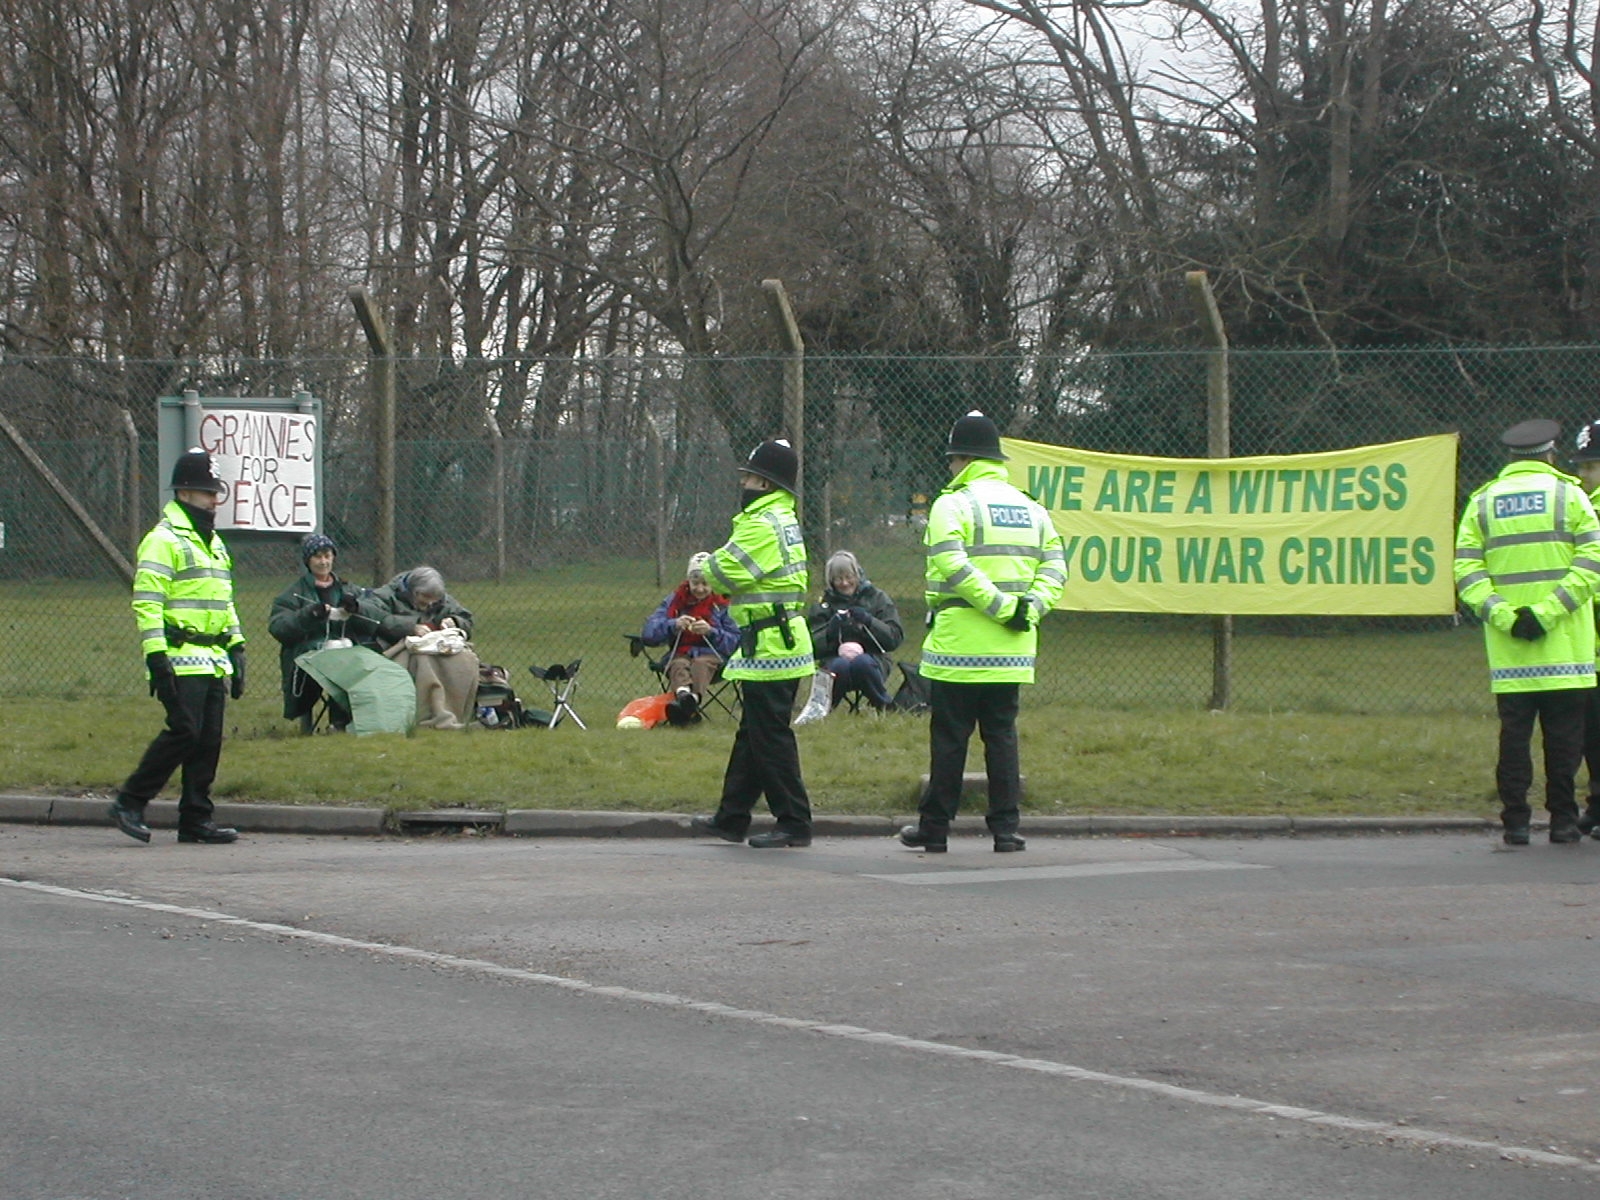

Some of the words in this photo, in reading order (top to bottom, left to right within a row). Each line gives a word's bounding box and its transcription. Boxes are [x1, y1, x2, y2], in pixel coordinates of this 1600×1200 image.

[200, 413, 317, 463] GRANNIES
[240, 456, 279, 484] FOR
[1028, 465, 1085, 511] WE
[1093, 469, 1177, 513] ARE
[1185, 471, 1212, 514] A
[1228, 462, 1408, 514] WITNESS
[990, 507, 1031, 525] POLICE
[1496, 494, 1544, 515] POLICE
[1176, 537, 1265, 584] WAR
[1279, 536, 1436, 585] CRIMES
